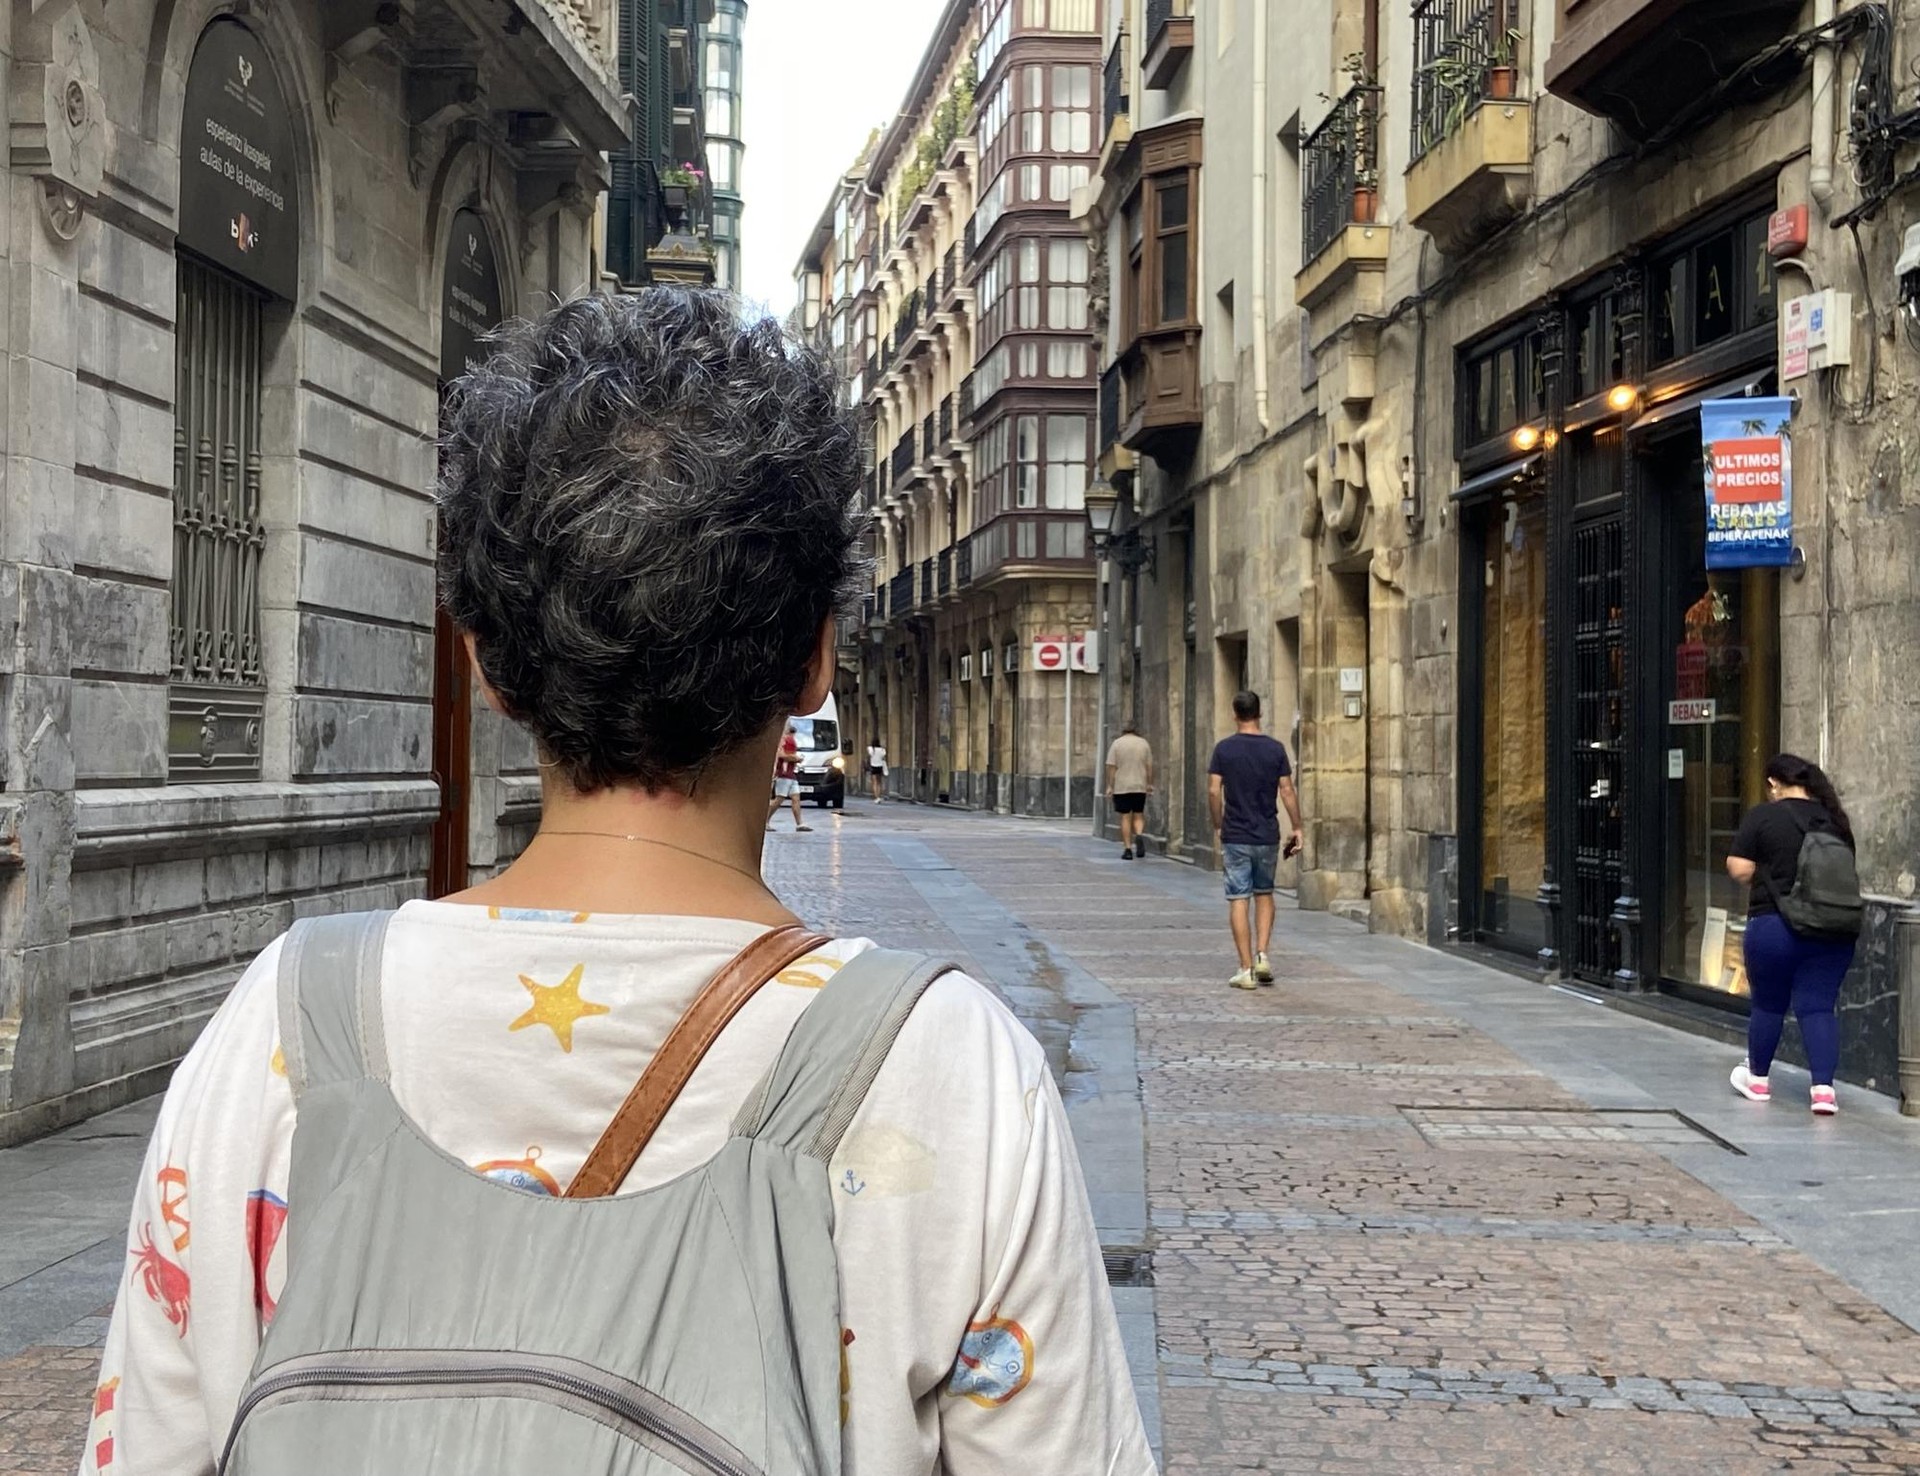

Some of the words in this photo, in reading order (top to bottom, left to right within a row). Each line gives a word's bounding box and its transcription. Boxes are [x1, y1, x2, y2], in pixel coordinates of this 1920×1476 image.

[200, 146, 222, 173] aulas
[223, 158, 236, 180] de
[236, 163, 244, 186] la
[244, 173, 284, 211] experiencia
[1715, 453, 1779, 469] ULTIMOS
[1716, 471, 1780, 487] PRECIOS
[1710, 501, 1787, 519] REBAJAS
[1716, 513, 1776, 529] SALES
[1708, 528, 1789, 542] BEHERAPENAK
